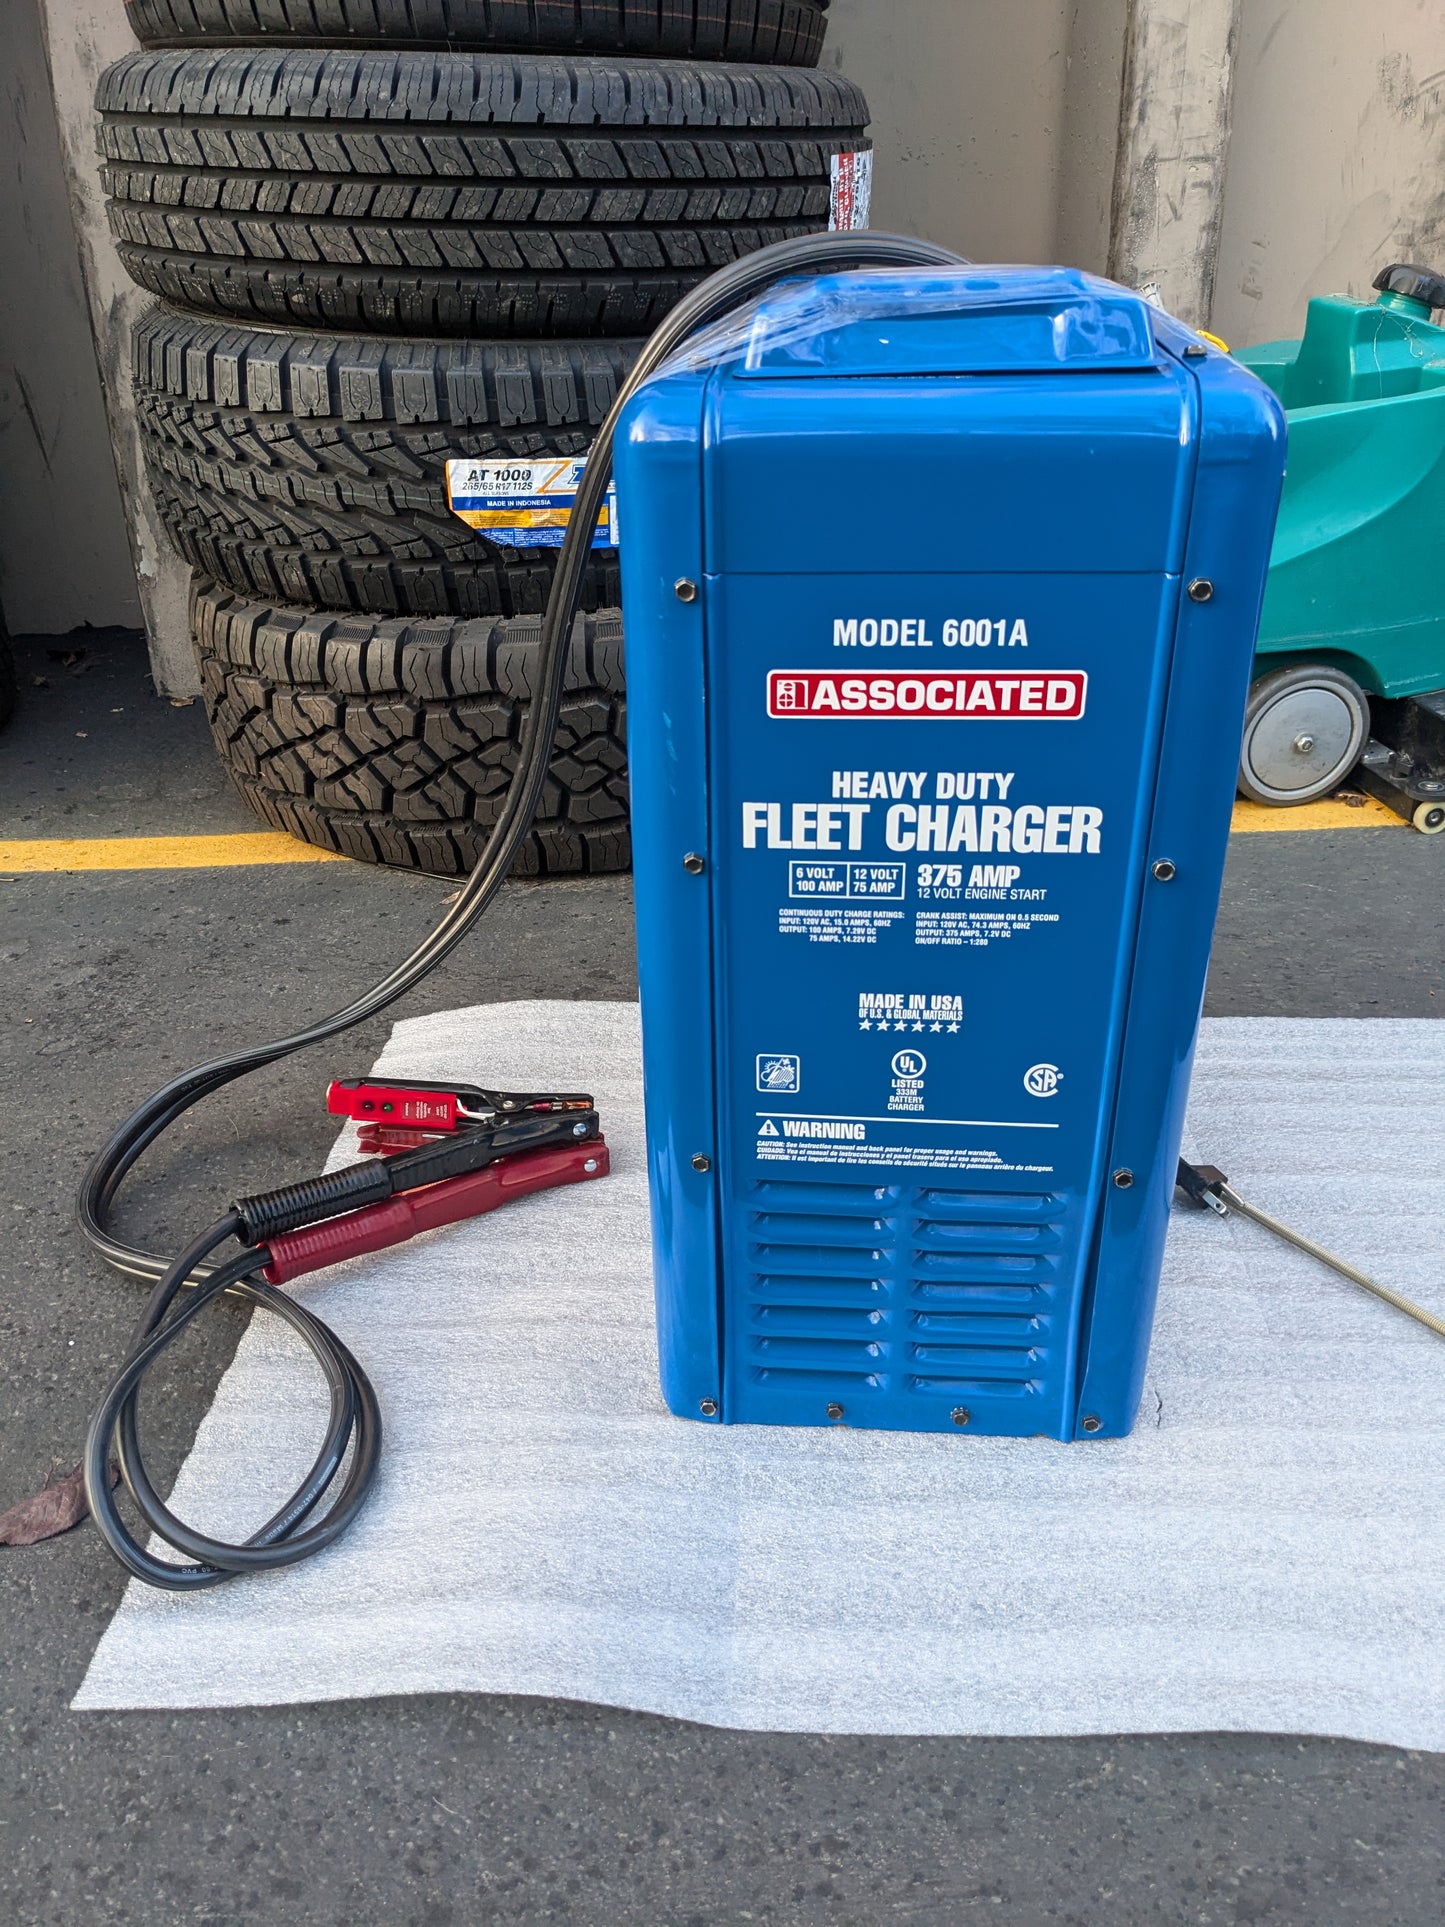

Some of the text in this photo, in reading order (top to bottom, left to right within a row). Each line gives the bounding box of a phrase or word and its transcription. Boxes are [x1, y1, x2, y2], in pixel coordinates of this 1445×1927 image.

[467, 469, 531, 482] AT 1000
[496, 482, 512, 490] R17
[513, 481, 533, 490] 112S
[833, 618, 1029, 647] MODEL 6001A
[811, 678, 1077, 711] ASSOCIATED
[832, 771, 1015, 800] HEAVY DUTY
[742, 802, 1104, 854] FLEET CHARGER
[796, 867, 835, 879] 6 VOLT
[853, 868, 899, 881] 12 VOLT
[917, 864, 1022, 888] 375 AMP
[796, 880, 844, 893] 100 AMP
[853, 881, 896, 893] 75 AMP
[917, 887, 1047, 901] 12 VOLT ENGINE START
[779, 908, 823, 917] CONTINUOUS
[844, 910, 872, 918] CHARGE
[873, 911, 905, 919] RATINGS:
[916, 912, 940, 920] CRANK
[941, 912, 968, 920] ASSIST:
[969, 913, 1004, 921] MAXIMUM
[1006, 913, 1016, 921] ON
[779, 917, 801, 925] INPUT:
[803, 918, 820, 926] 120V
[916, 920, 938, 928] INPUT:
[958, 921, 970, 929] AC,
[988, 922, 1011, 930] AMPS,
[1012, 922, 1031, 930] 60HZ
[779, 925, 808, 933] OUTPUT:
[822, 927, 844, 935] AMPS,
[915, 929, 1011, 938] OUTPUT: 375 AMPS, 7.2V DC
[818, 935, 841, 943] AMPS,
[915, 937, 940, 945] ON/OFF
[859, 993, 963, 1011] MADE IN USA
[858, 1008, 963, 1021] OF U.S. & GLOBAL MATERIALS
[900, 1056, 917, 1073] UL
[891, 1079, 924, 1089] LISTED
[889, 1096, 924, 1104] BATTERY
[888, 1103, 925, 1111] CHARGER
[783, 1121, 866, 1140] WARNING
[757, 1140, 785, 1148] CAUTION:
[808, 1155, 836, 1163] important
